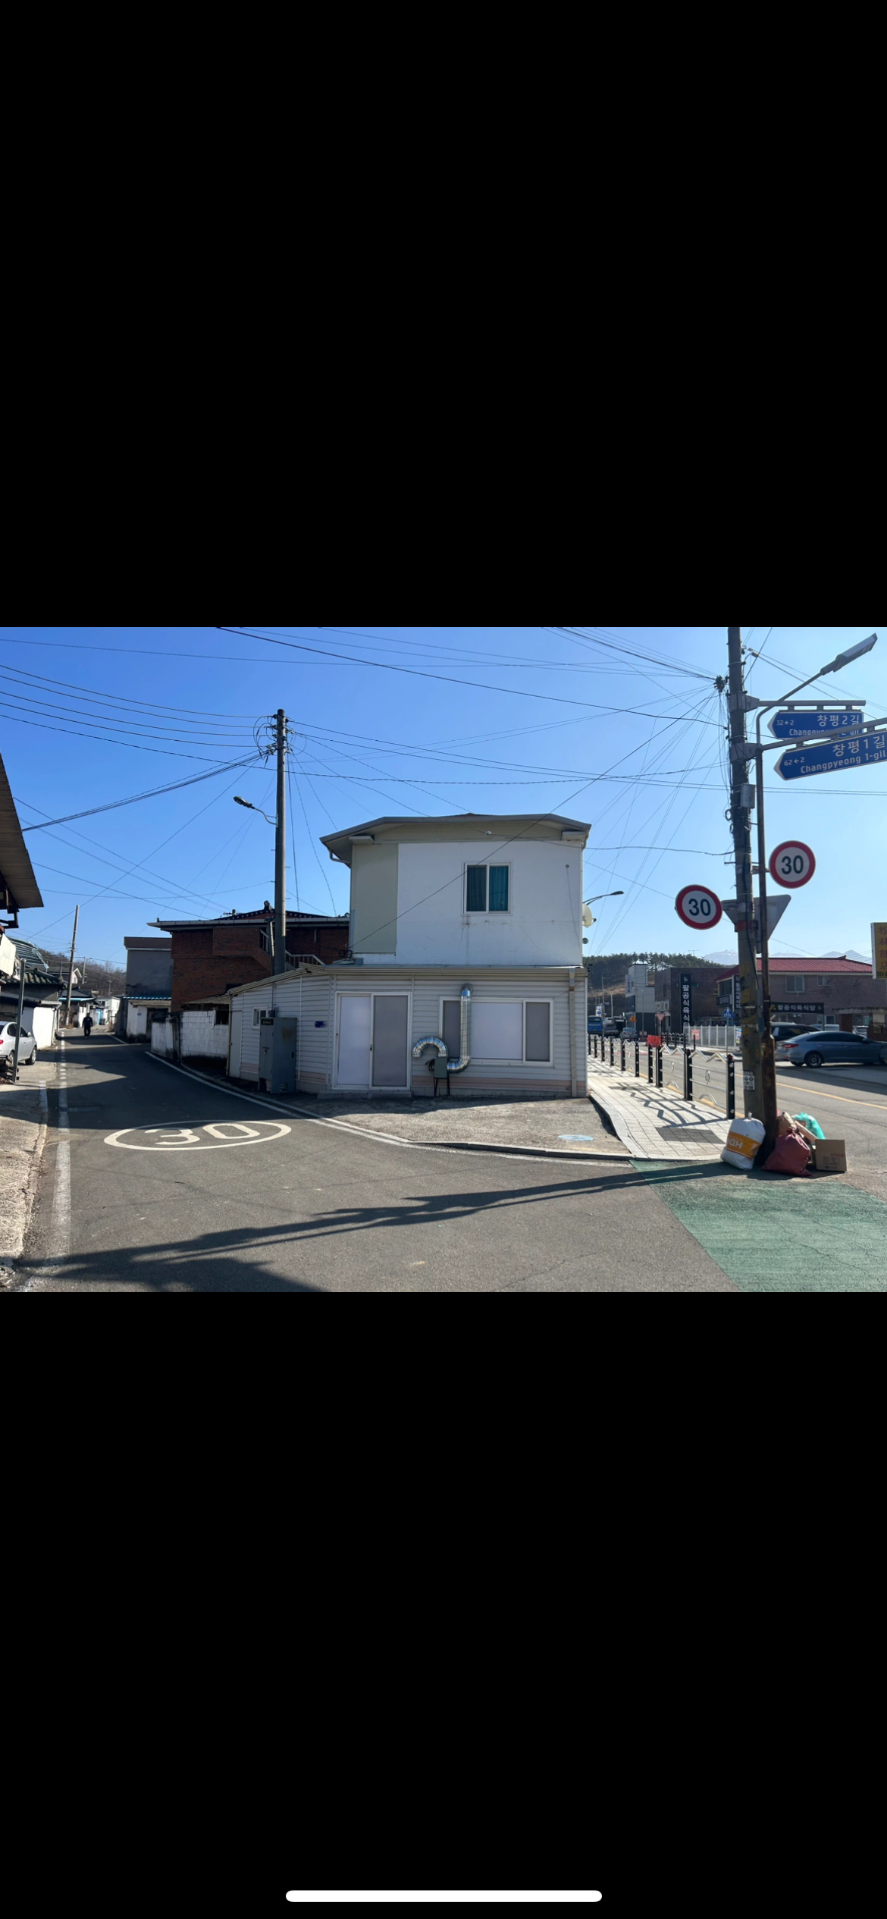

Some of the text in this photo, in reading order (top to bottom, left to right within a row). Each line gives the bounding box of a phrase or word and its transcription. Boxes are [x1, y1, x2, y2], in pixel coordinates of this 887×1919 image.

[832, 734, 886, 757] 창평1길
[784, 759, 793, 767] 62
[800, 750, 887, 774] Changpyeong 1-gil
[781, 855, 804, 875] 30
[688, 898, 711, 917] 30
[777, 1004, 816, 1012] 팔공식육식당
[144, 1122, 261, 1145] 30
